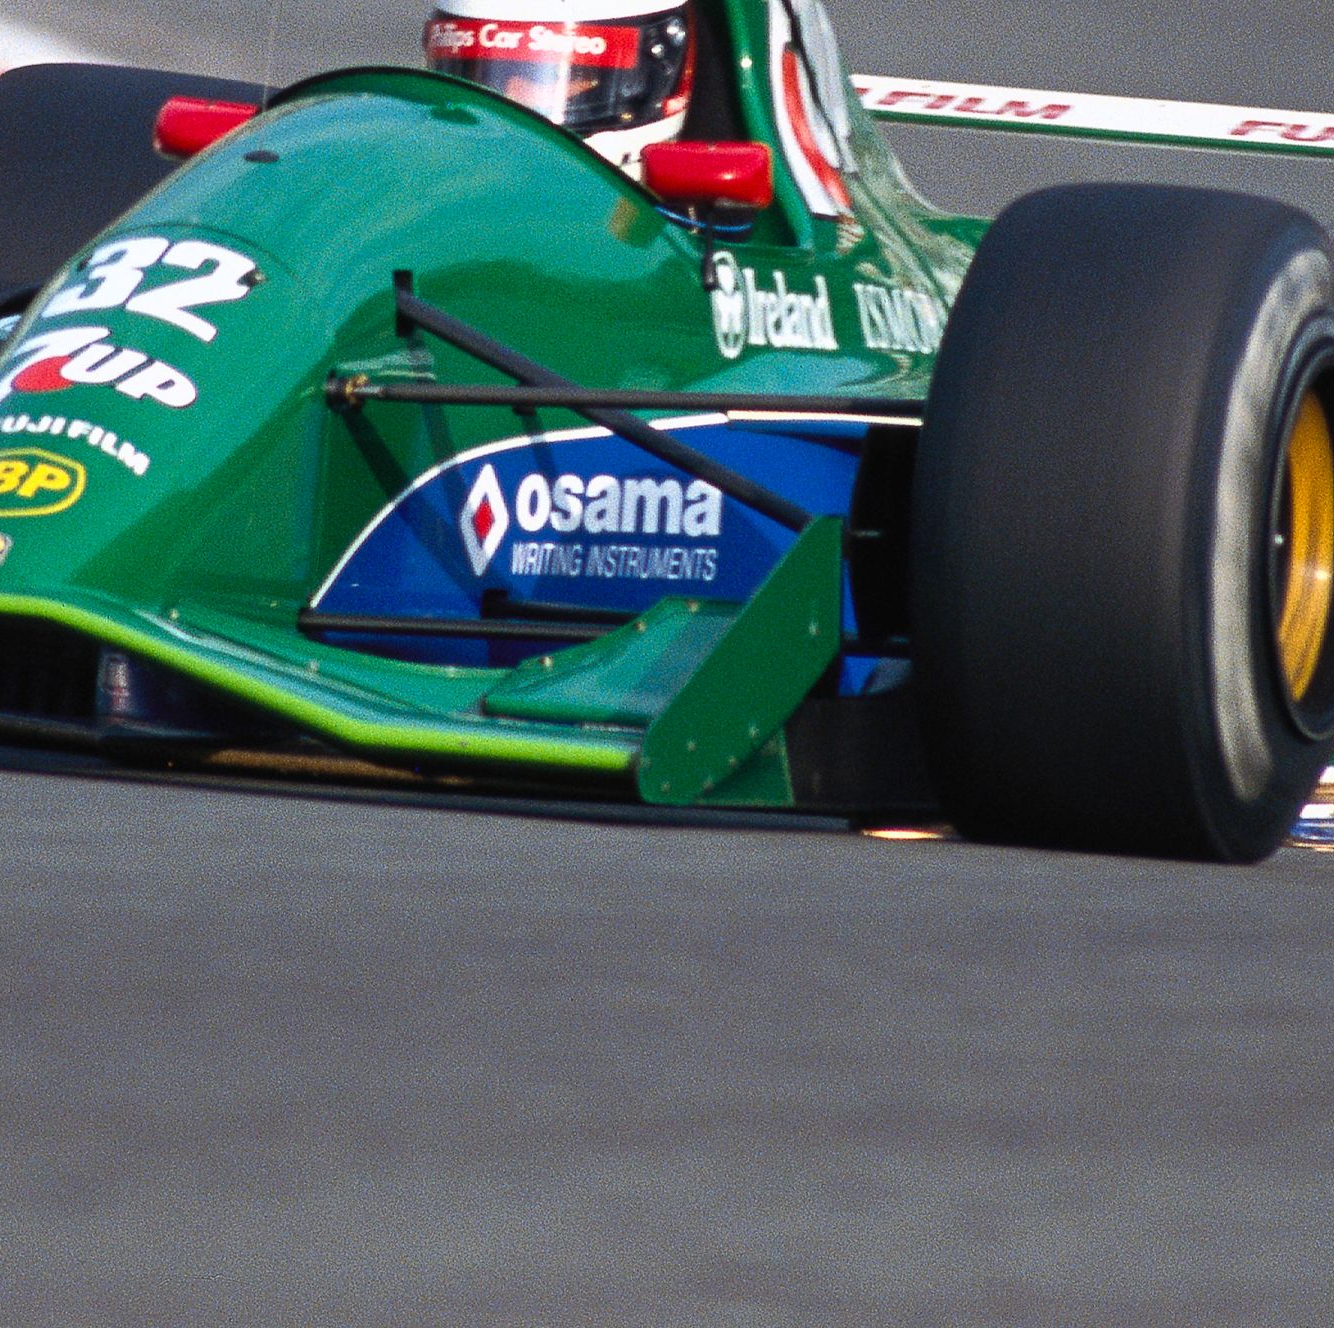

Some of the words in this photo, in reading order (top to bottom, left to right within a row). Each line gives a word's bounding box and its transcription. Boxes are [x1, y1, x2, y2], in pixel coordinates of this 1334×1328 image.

[478, 23, 523, 48] Car
[41, 237, 258, 343] 32
[742, 268, 838, 351] Ireland
[515, 473, 722, 537] osama
[511, 543, 582, 577] WRITING
[585, 545, 717, 582] INSTRUMENTS
